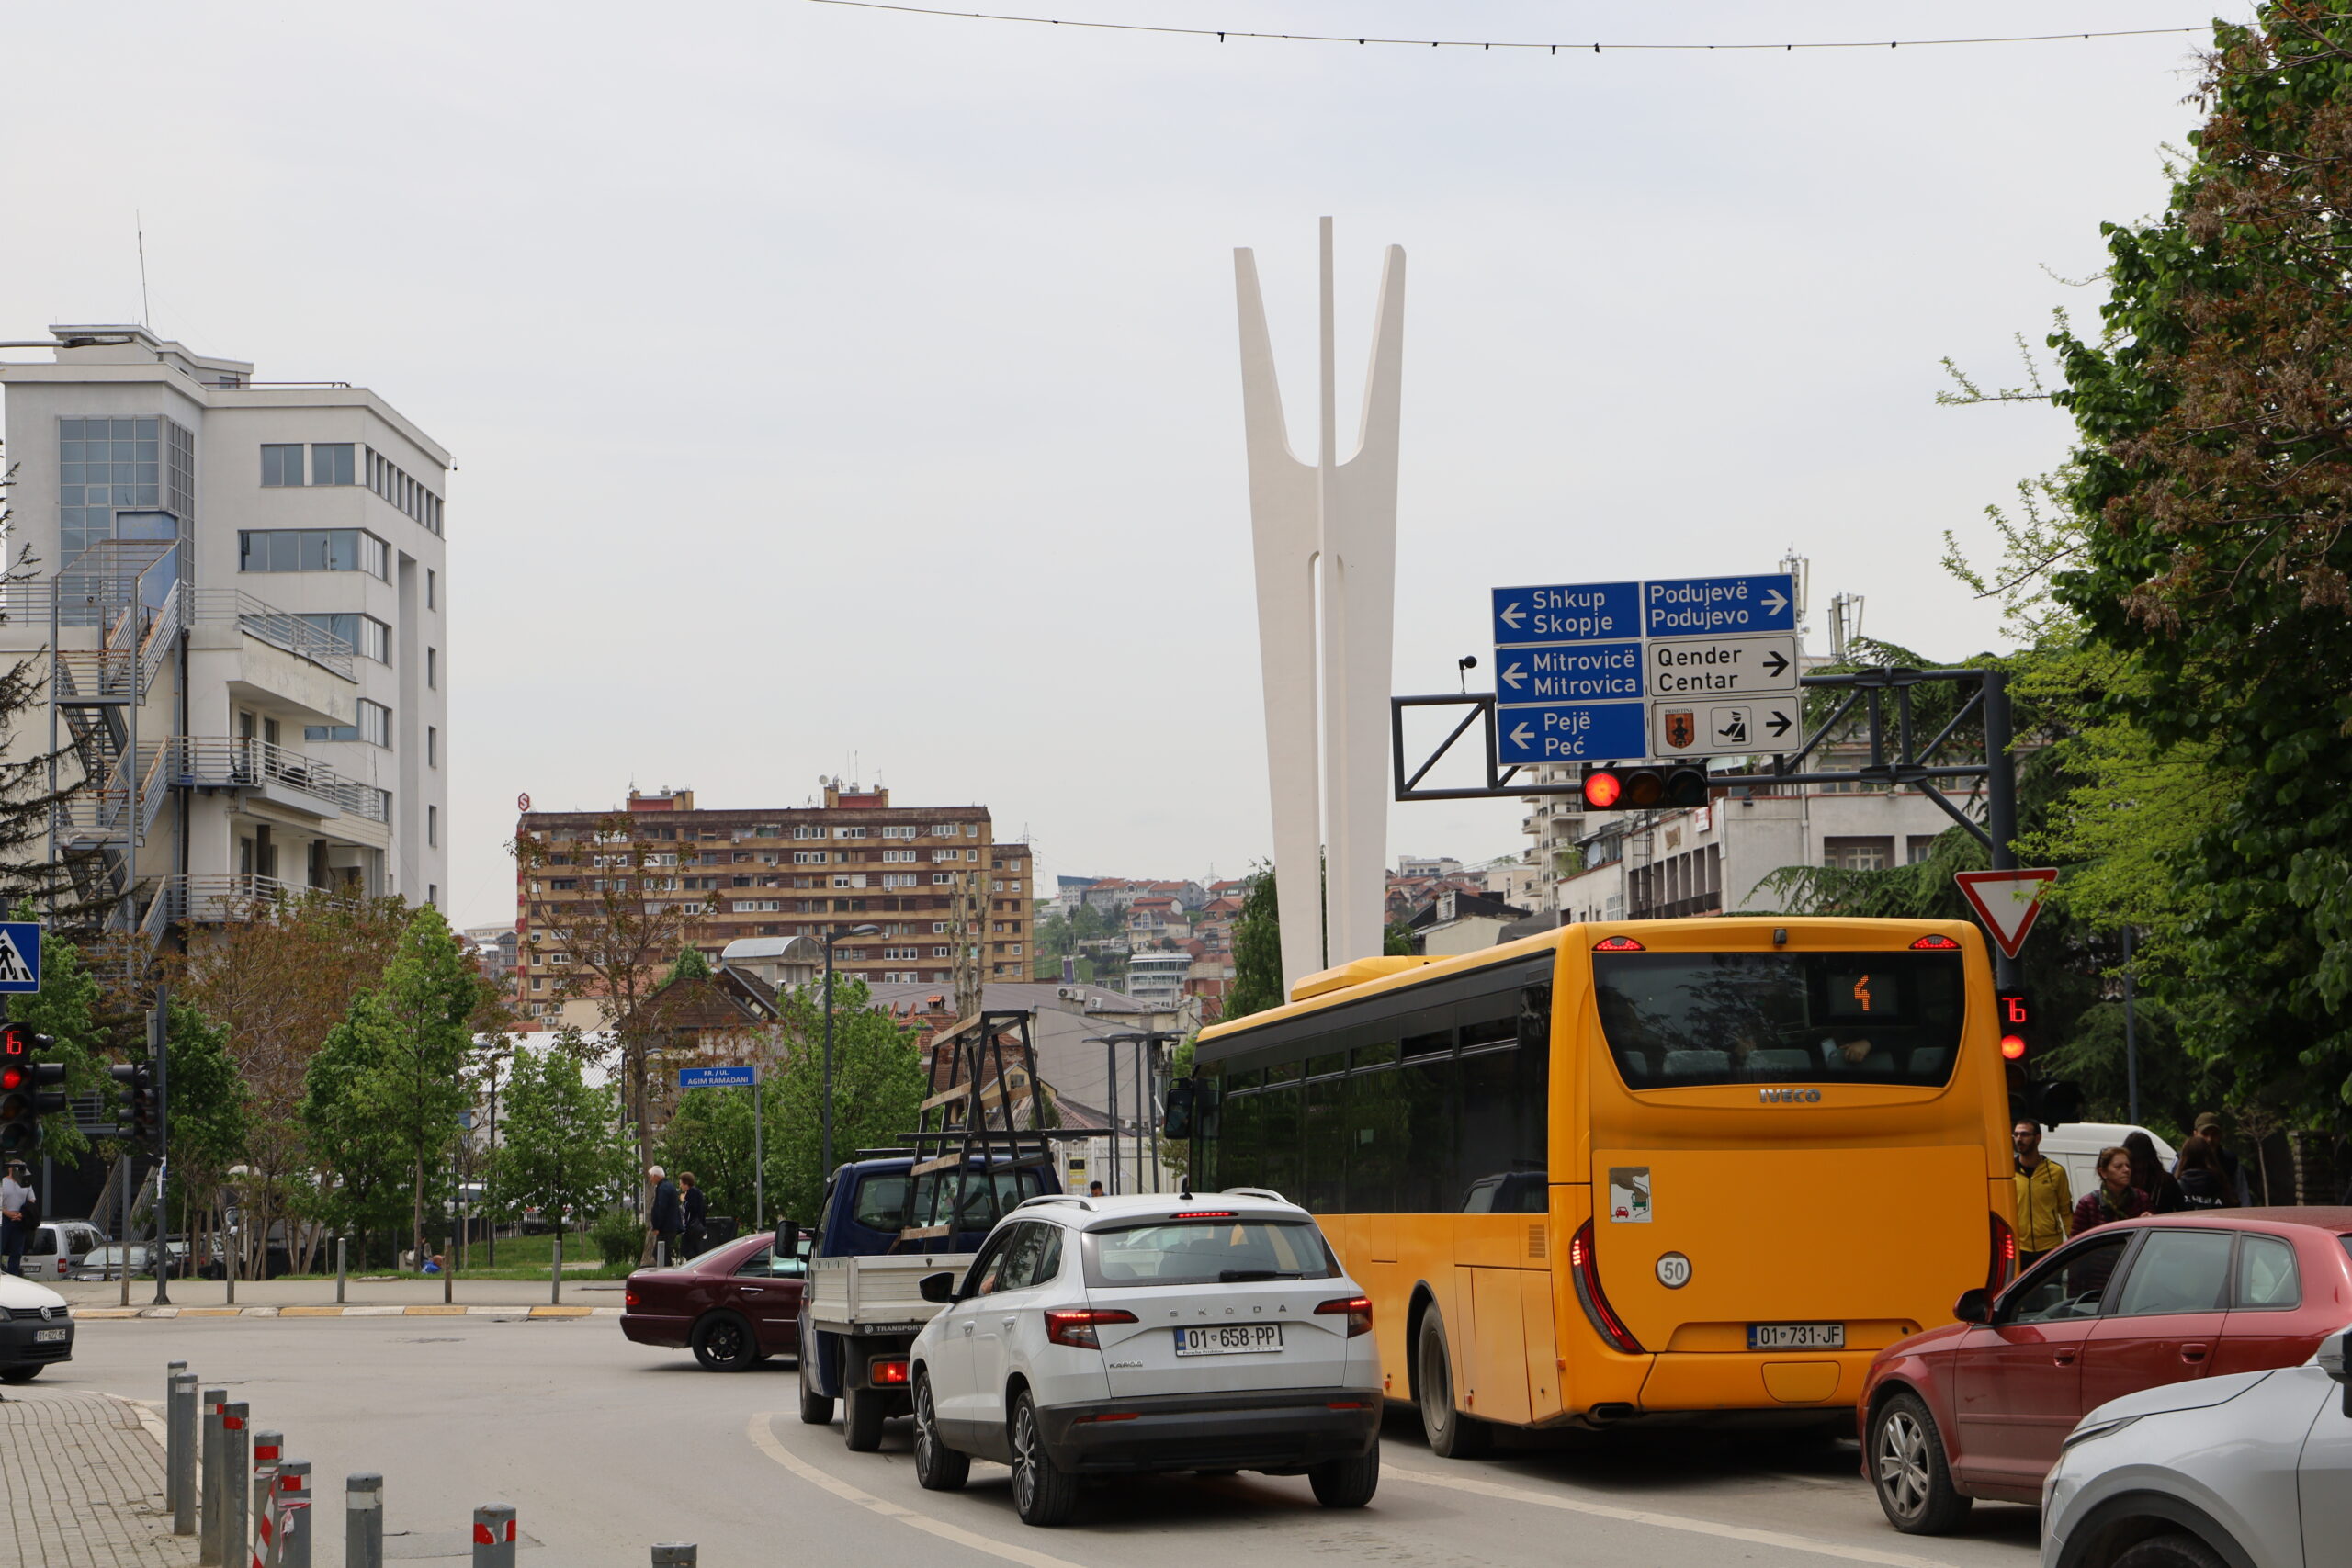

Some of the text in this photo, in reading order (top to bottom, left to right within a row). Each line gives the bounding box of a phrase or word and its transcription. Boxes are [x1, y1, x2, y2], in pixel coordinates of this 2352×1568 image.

[1532, 589, 1606, 611] Shkup
[1650, 581, 1748, 606] Podujevë
[1533, 612, 1613, 637] Skopje
[1651, 606, 1749, 630] Podujevo
[1533, 649, 1635, 672] Mitrovicë
[1658, 646, 1742, 667] Qender
[1534, 674, 1636, 696] Mitrovica
[1659, 672, 1739, 692] Centar
[1544, 711, 1591, 735] Pejë
[1544, 736, 1585, 757] Peć
[1854, 974, 1871, 1010] 4
[2002, 997, 2027, 1022] 76
[708, 1076, 749, 1085] RAMADANI
[1759, 1089, 1822, 1103] IVECO
[1664, 1261, 1685, 1280] 50
[1189, 1326, 1275, 1348] 01 658-PP
[1760, 1326, 1840, 1345] 01 731-JF
